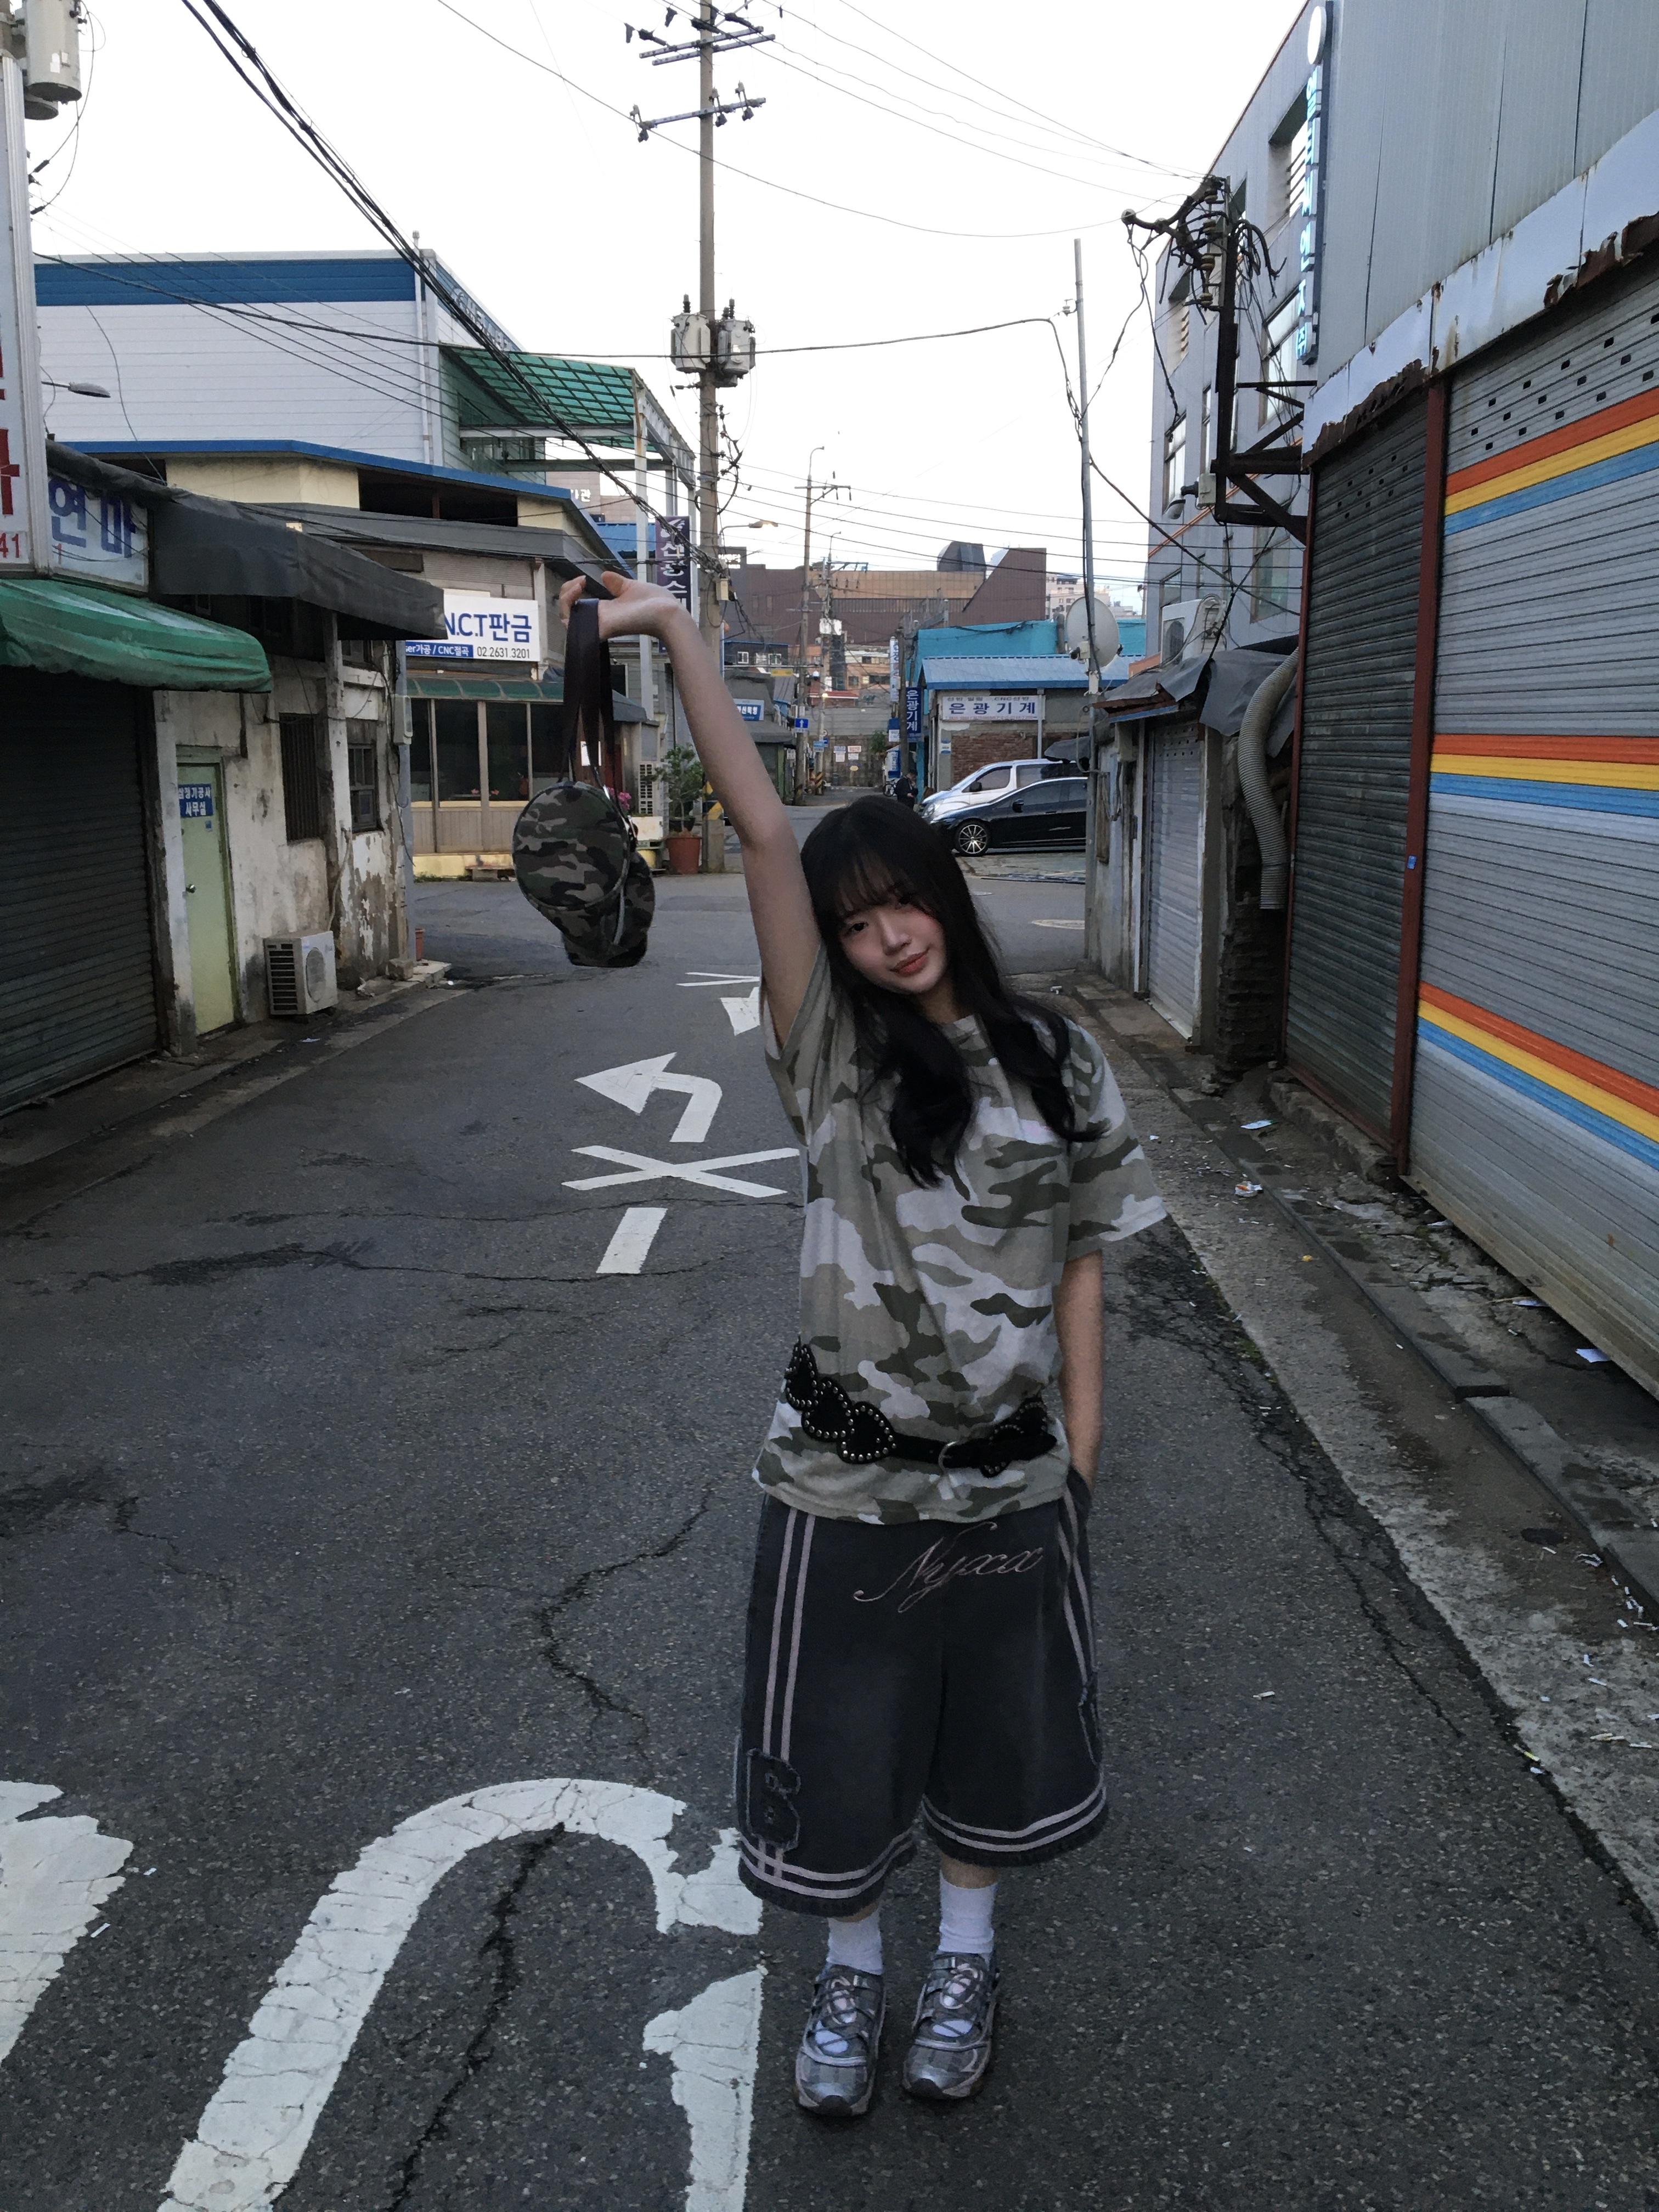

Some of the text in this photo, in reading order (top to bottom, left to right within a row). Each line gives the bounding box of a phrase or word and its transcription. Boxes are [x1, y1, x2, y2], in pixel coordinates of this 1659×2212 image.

[438, 646, 470, 657] CNC절곡
[477, 646, 530, 658] 02.2631.3201
[906, 690, 920, 731] 은광기계
[185, 802, 206, 817] 사무실
